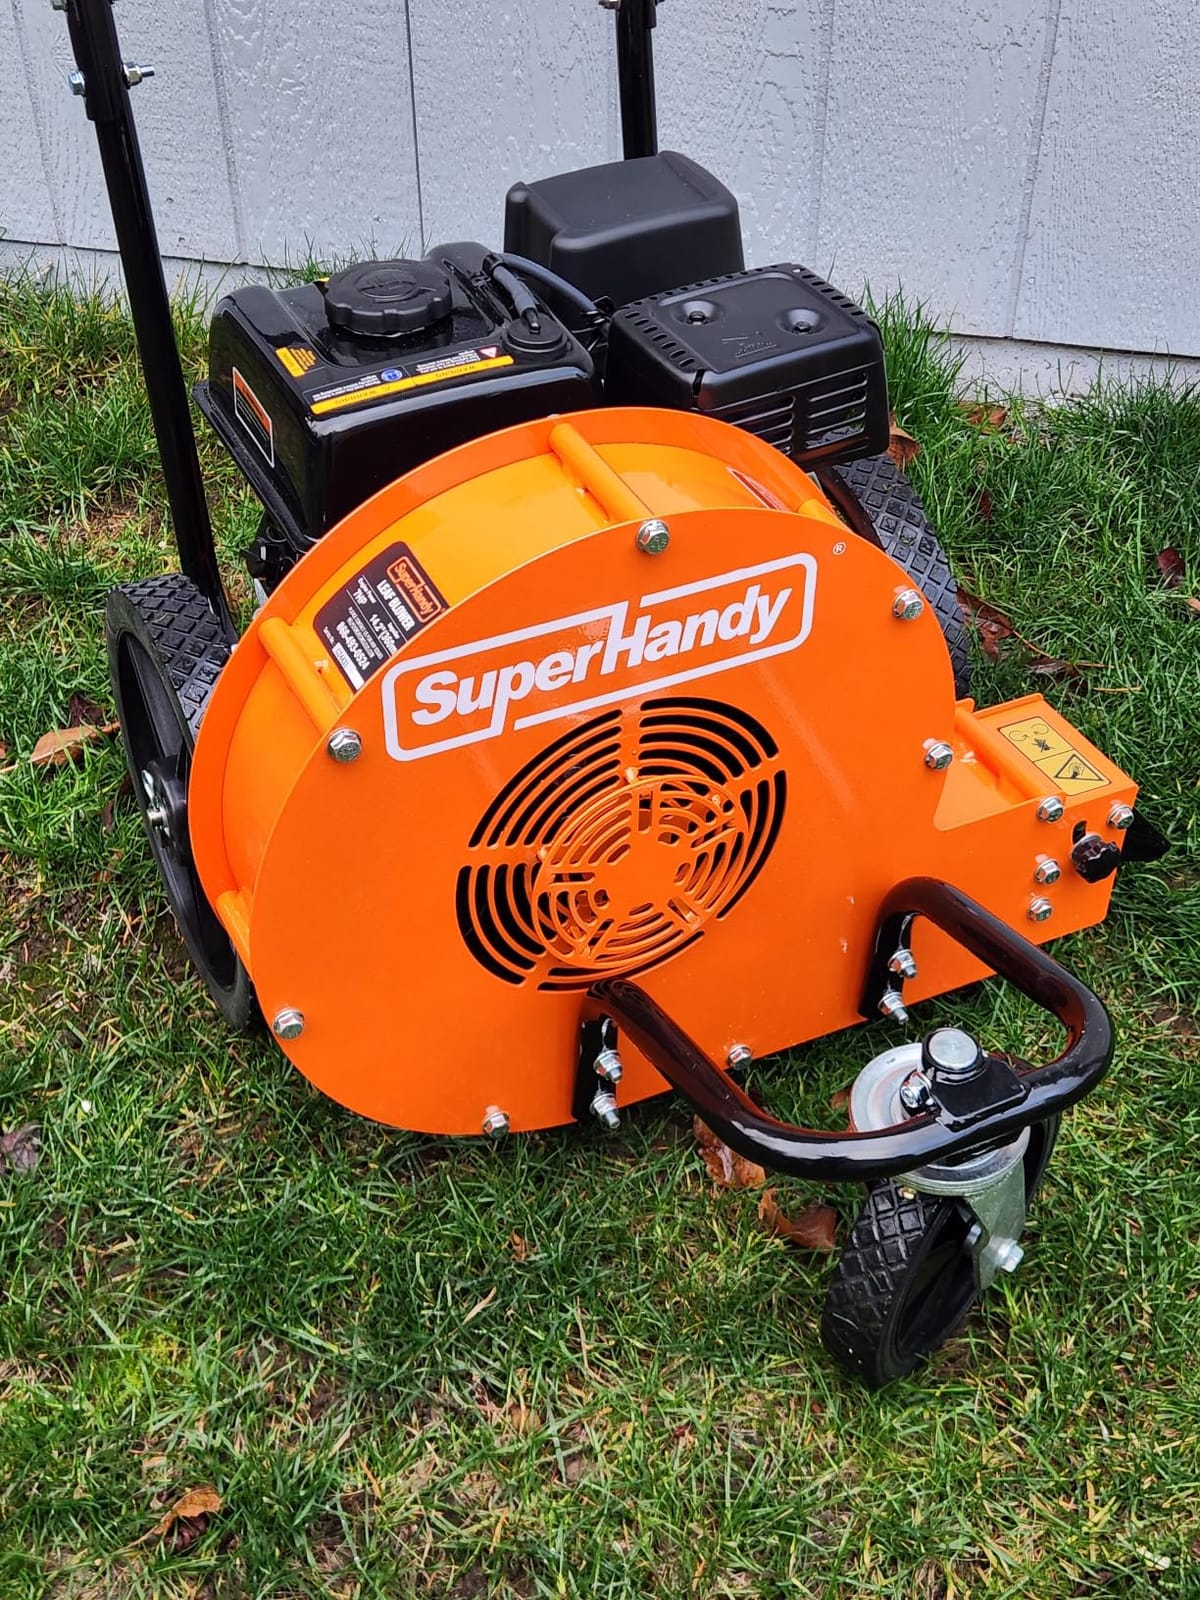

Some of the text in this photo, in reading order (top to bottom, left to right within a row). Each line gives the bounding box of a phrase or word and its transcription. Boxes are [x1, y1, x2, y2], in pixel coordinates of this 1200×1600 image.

[353, 588, 368, 606] 7HP
[377, 579, 415, 632] LEAF BLOWER
[394, 561, 435, 616] SuperHandy
[410, 584, 793, 727] SuperHandy
